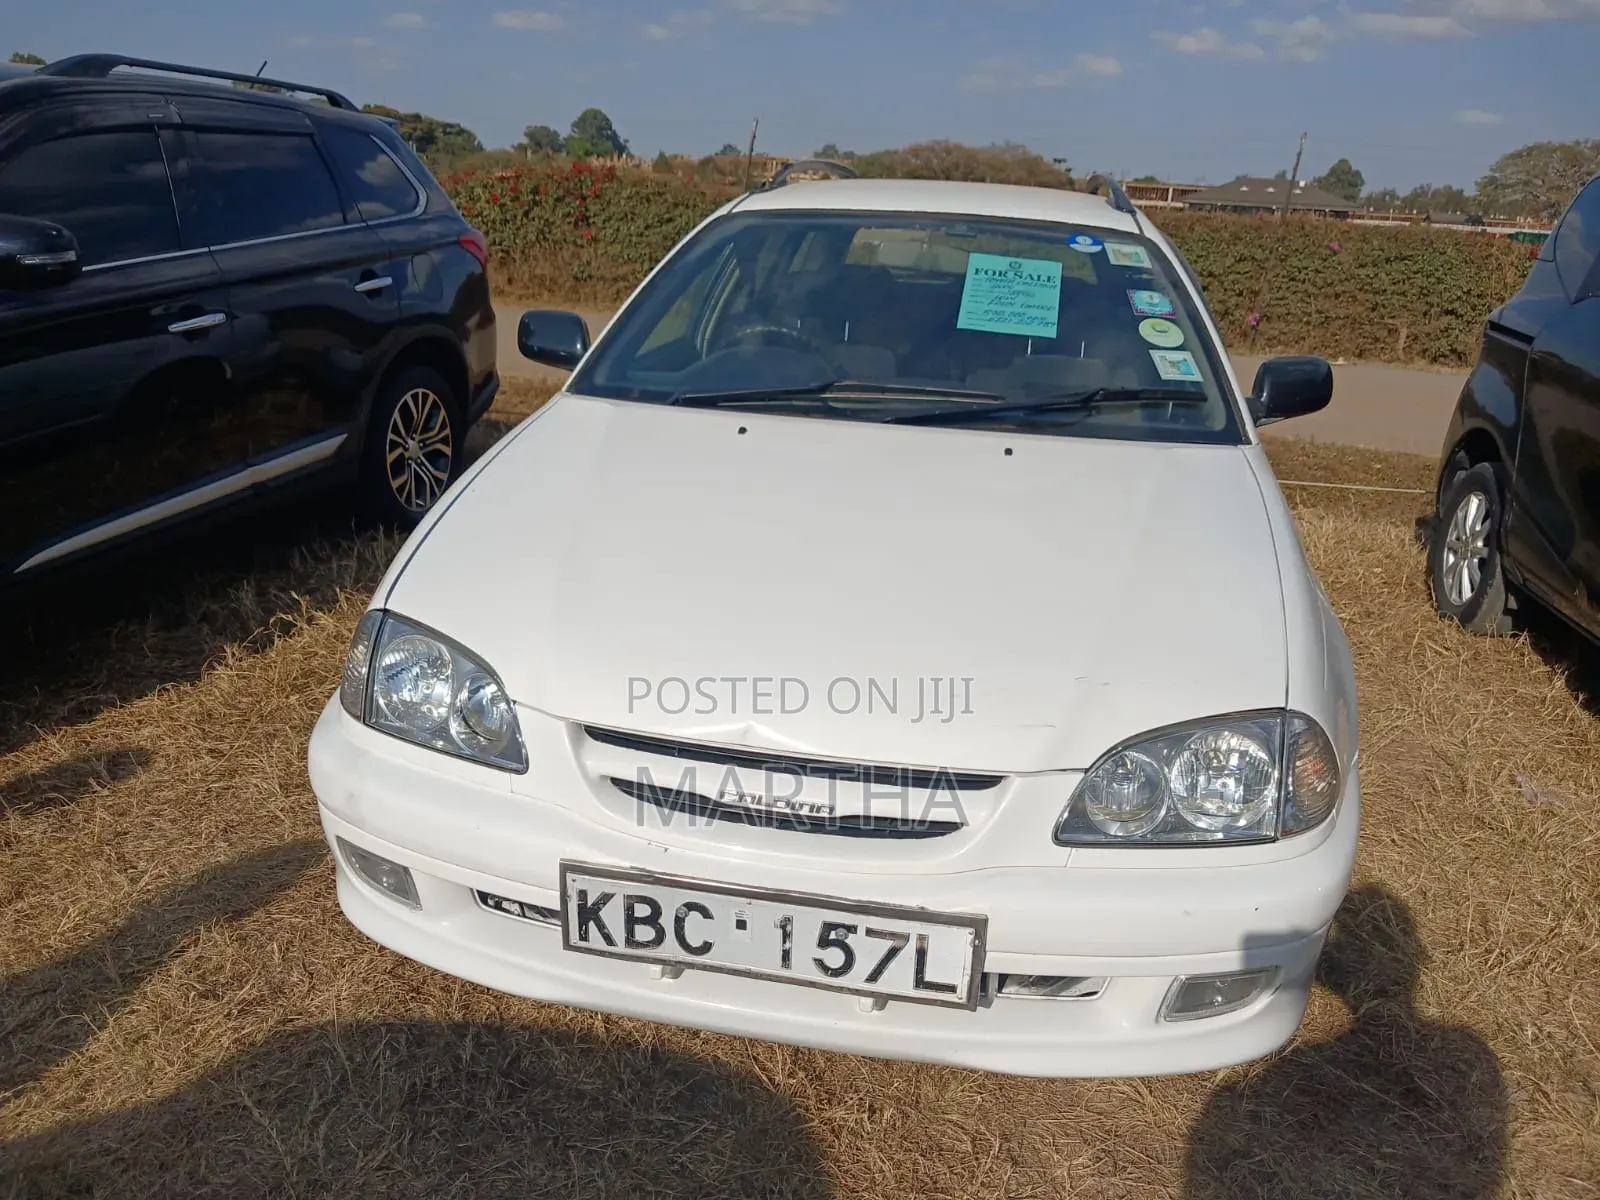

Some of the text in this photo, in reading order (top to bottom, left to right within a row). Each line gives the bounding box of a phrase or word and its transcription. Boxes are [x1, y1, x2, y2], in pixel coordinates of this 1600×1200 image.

[974, 267, 1008, 278] FOR
[1013, 271, 1057, 284] SALE
[576, 888, 957, 995] KBC 157L
